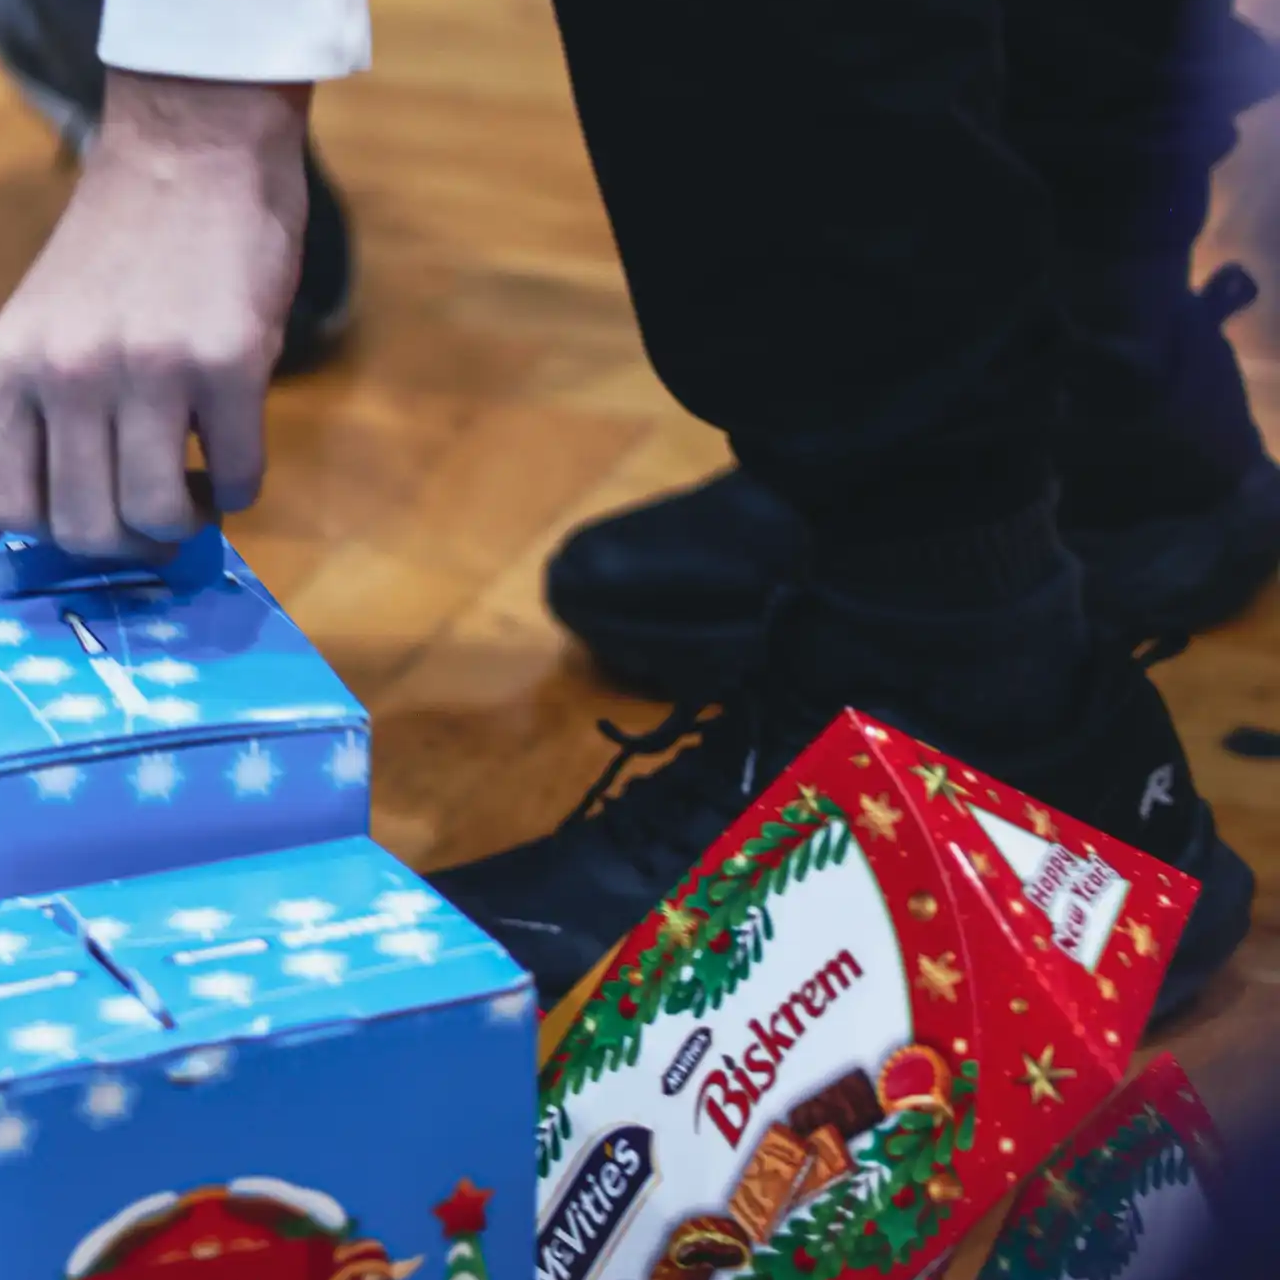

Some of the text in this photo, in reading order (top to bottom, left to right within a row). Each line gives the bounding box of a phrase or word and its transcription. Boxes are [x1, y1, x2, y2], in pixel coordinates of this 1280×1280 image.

[1028, 847, 1079, 909] Happy
[1057, 903, 1085, 950] New
[694, 949, 864, 1151] Biskrem
